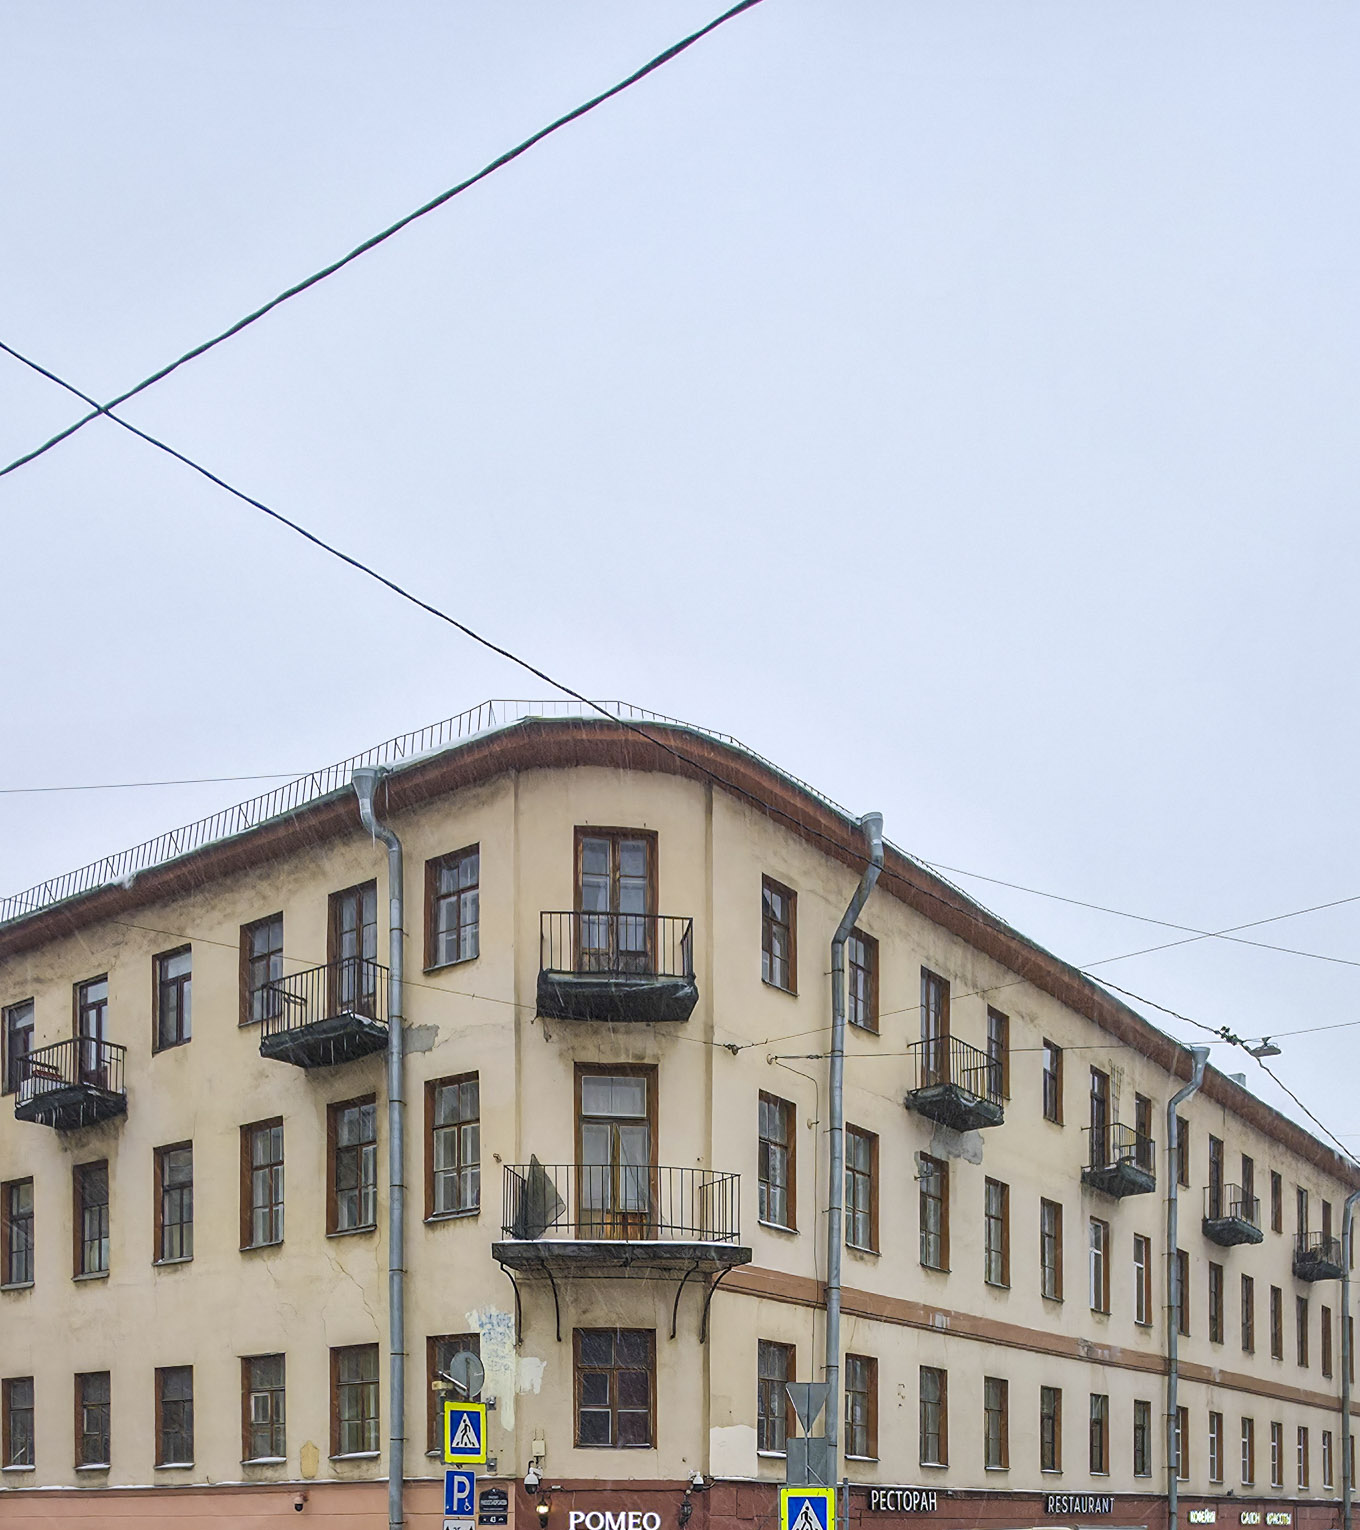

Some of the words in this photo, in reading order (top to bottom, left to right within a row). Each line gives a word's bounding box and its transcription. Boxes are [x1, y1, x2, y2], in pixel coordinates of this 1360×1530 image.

[871, 1490, 937, 1511] РЕСТОРАН
[1048, 1495, 1115, 1513] RESTAURANT
[568, 1510, 661, 1530] РОМЕО
[1240, 1511, 1261, 1525] САЛОН
